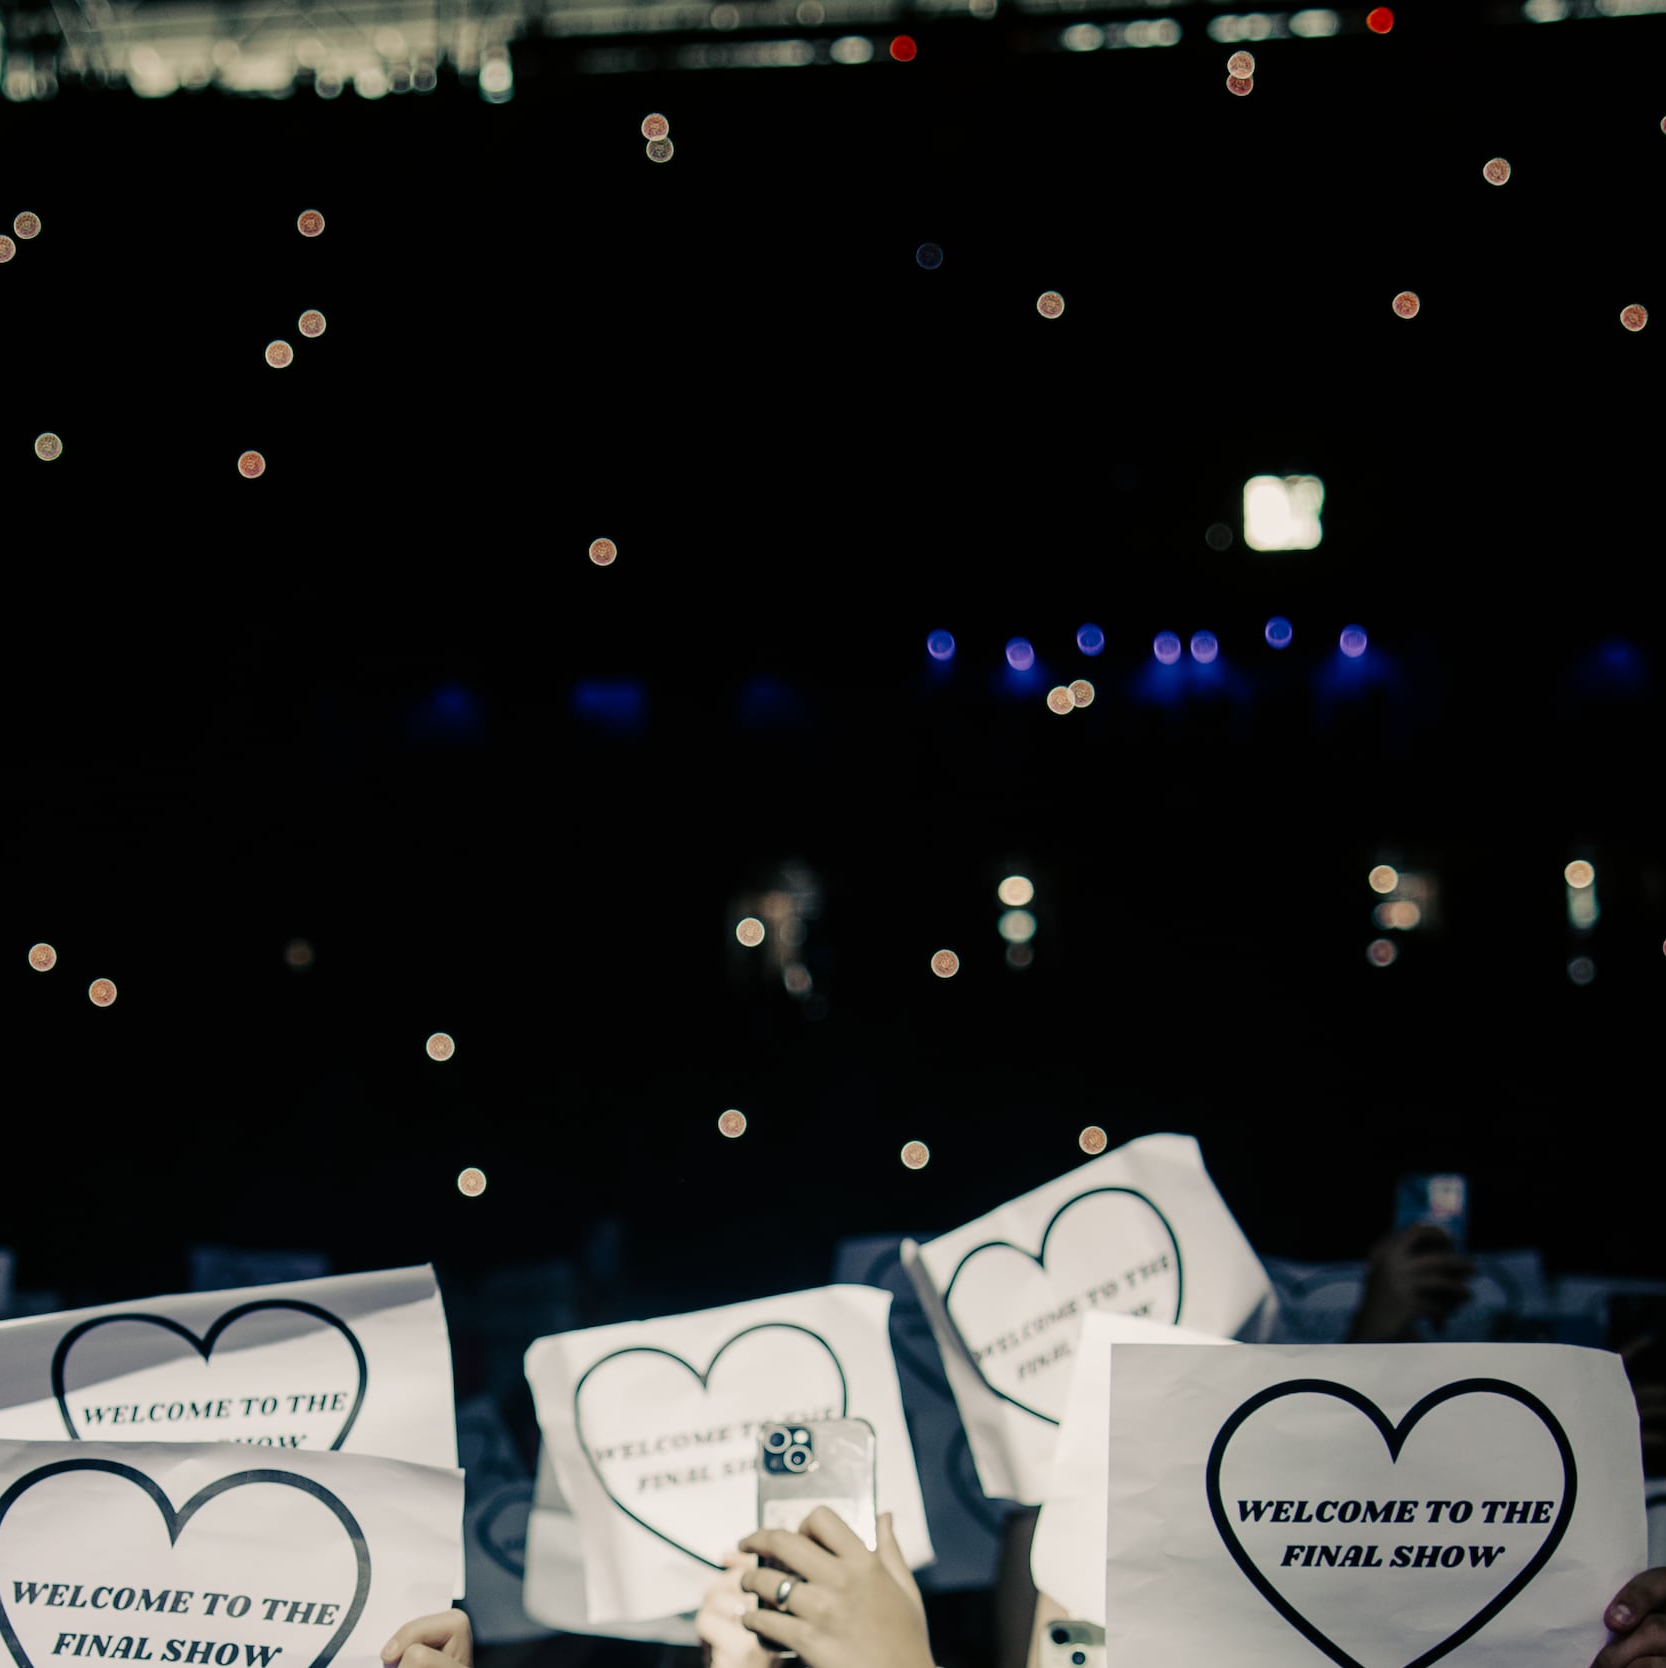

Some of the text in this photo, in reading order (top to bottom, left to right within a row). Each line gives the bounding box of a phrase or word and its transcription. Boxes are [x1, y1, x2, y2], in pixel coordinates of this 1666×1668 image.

[83, 1392, 349, 1425] WELCOME TO THE
[595, 1429, 728, 1462] WELCOME
[1237, 1500, 1555, 1524] WELCOME TO THE
[1280, 1545, 1505, 1568] FINAL SHOW
[12, 1580, 340, 1627] WELCOME TO THE
[51, 1631, 283, 1668] FINAL SHOW
